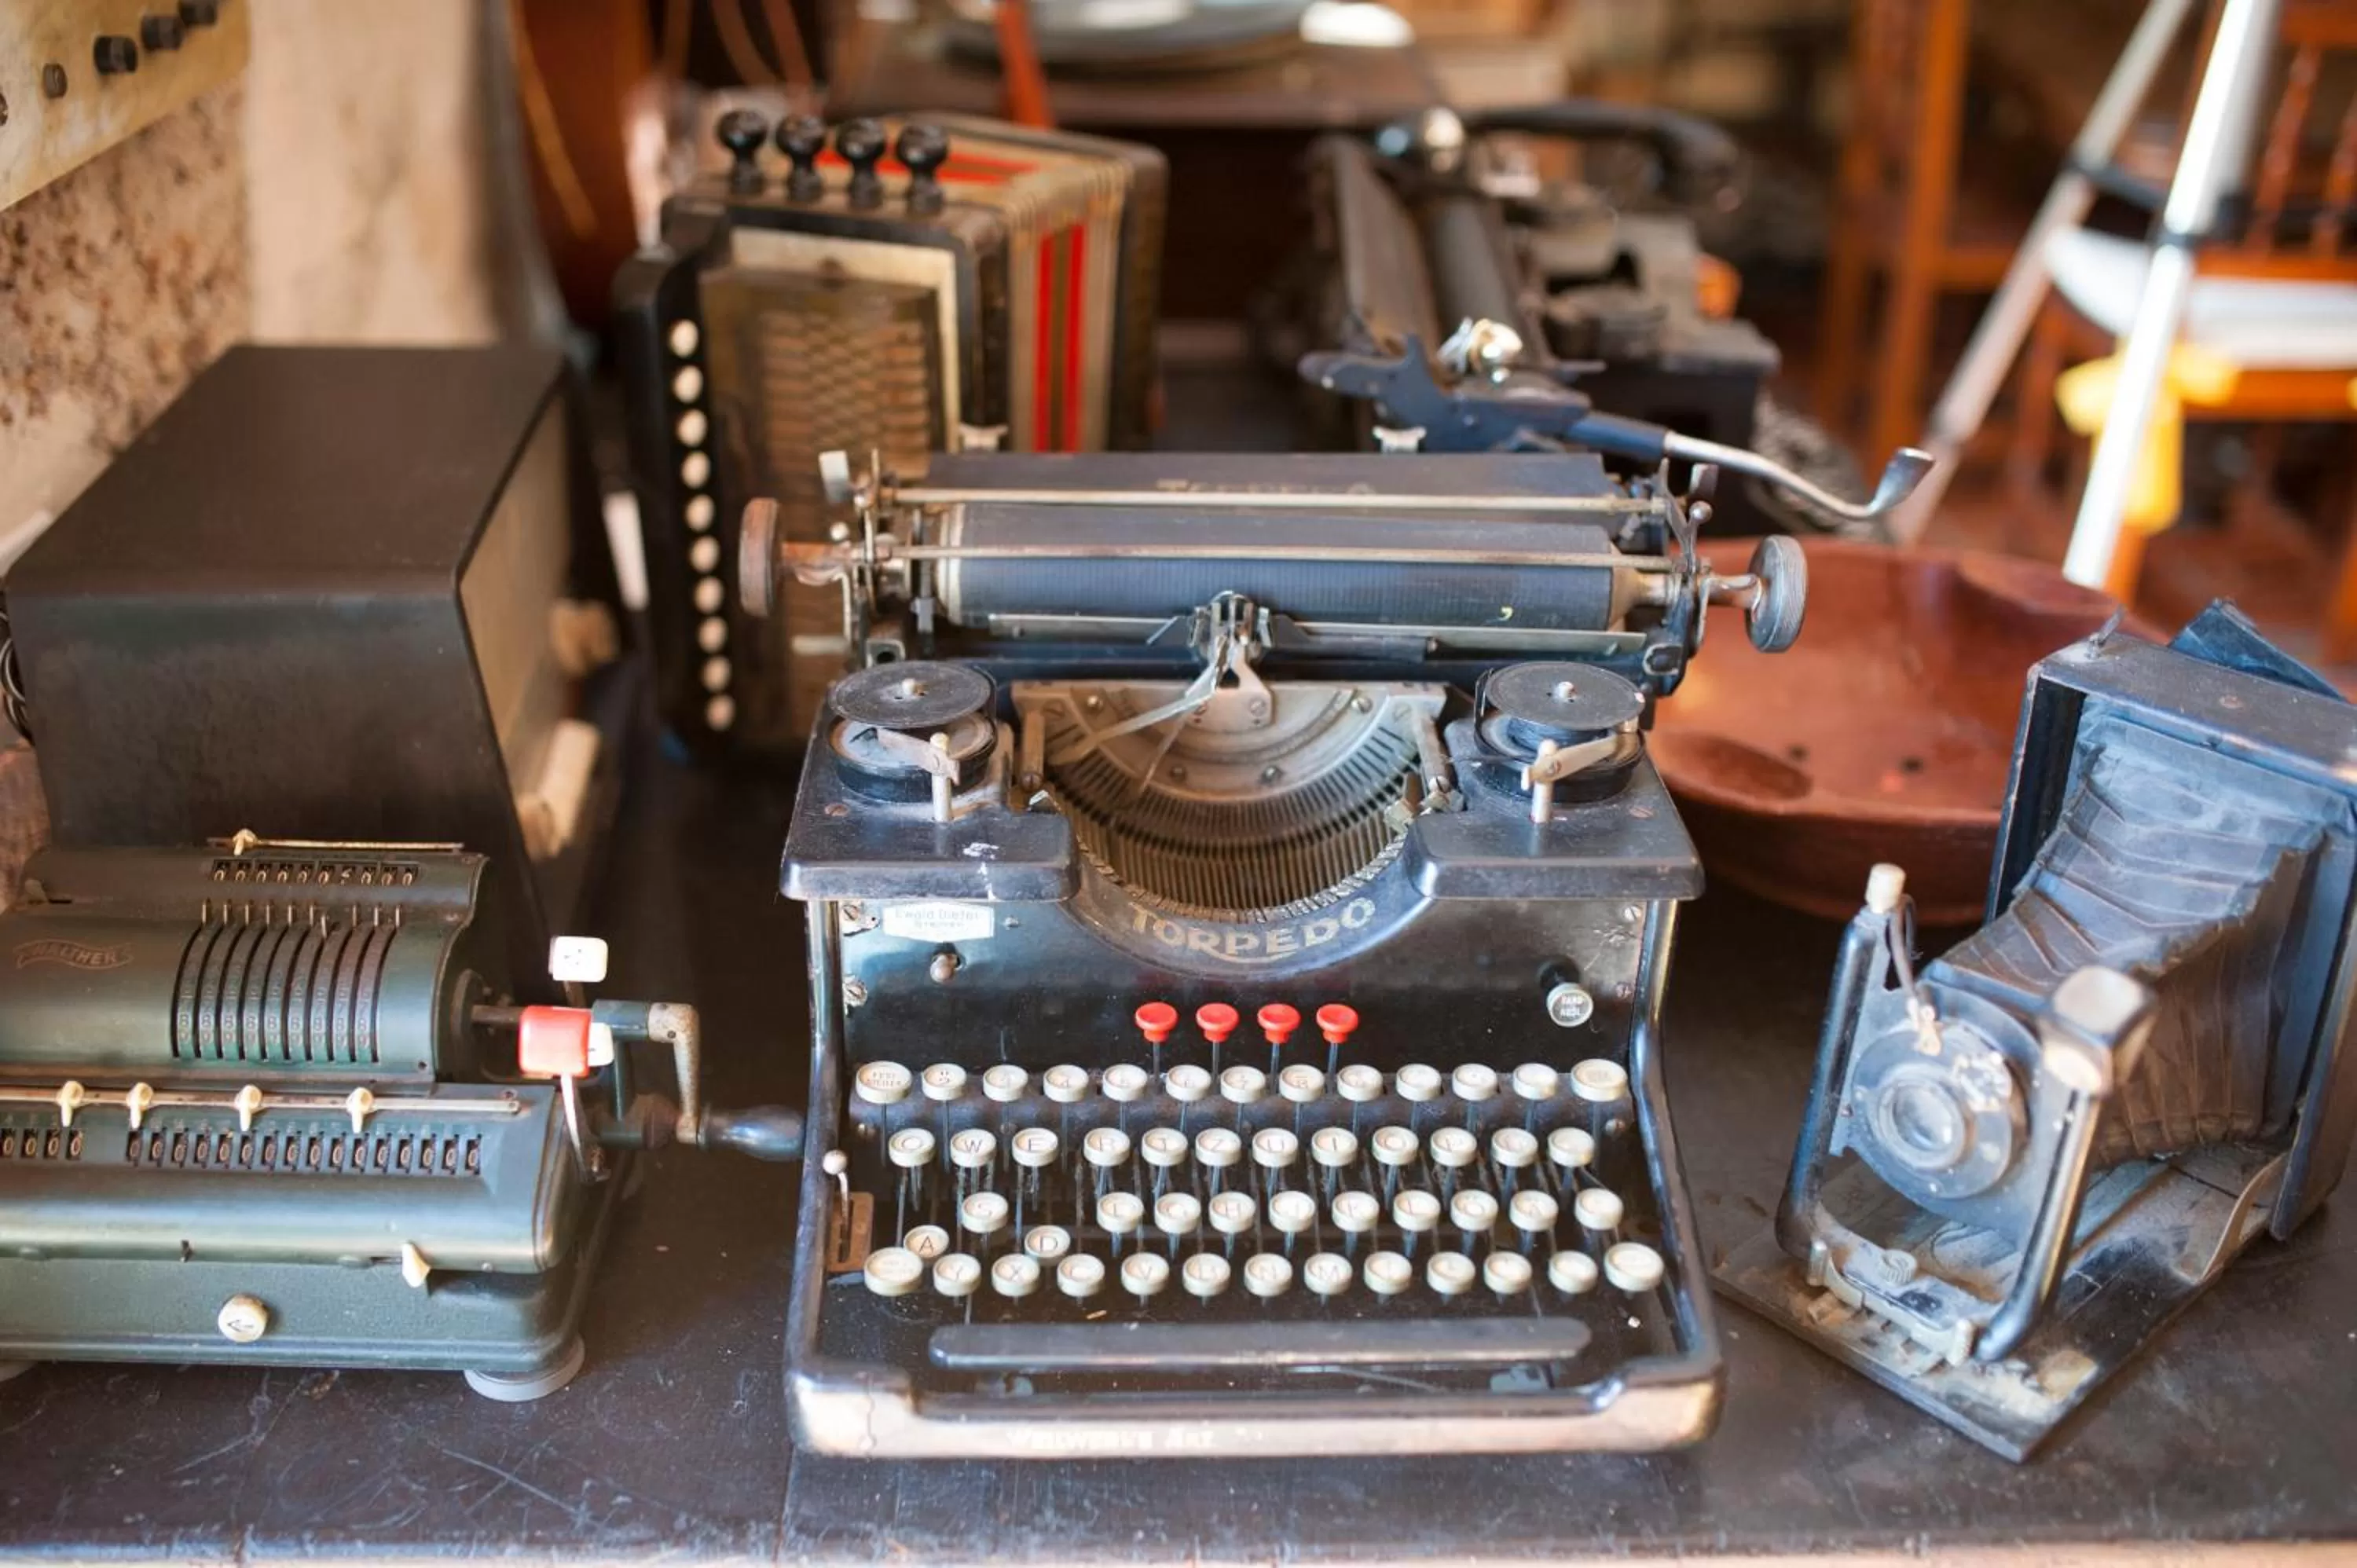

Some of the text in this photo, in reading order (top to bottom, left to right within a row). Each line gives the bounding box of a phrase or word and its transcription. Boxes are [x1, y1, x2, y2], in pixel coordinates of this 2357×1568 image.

[1128, 896, 1376, 963] TORPEDO
[964, 1138, 982, 1153] W
[1028, 1138, 1046, 1152] E
[1209, 1138, 1226, 1152] Z
[918, 1235, 1058, 1254] A D
[1136, 1264, 1153, 1280] V
